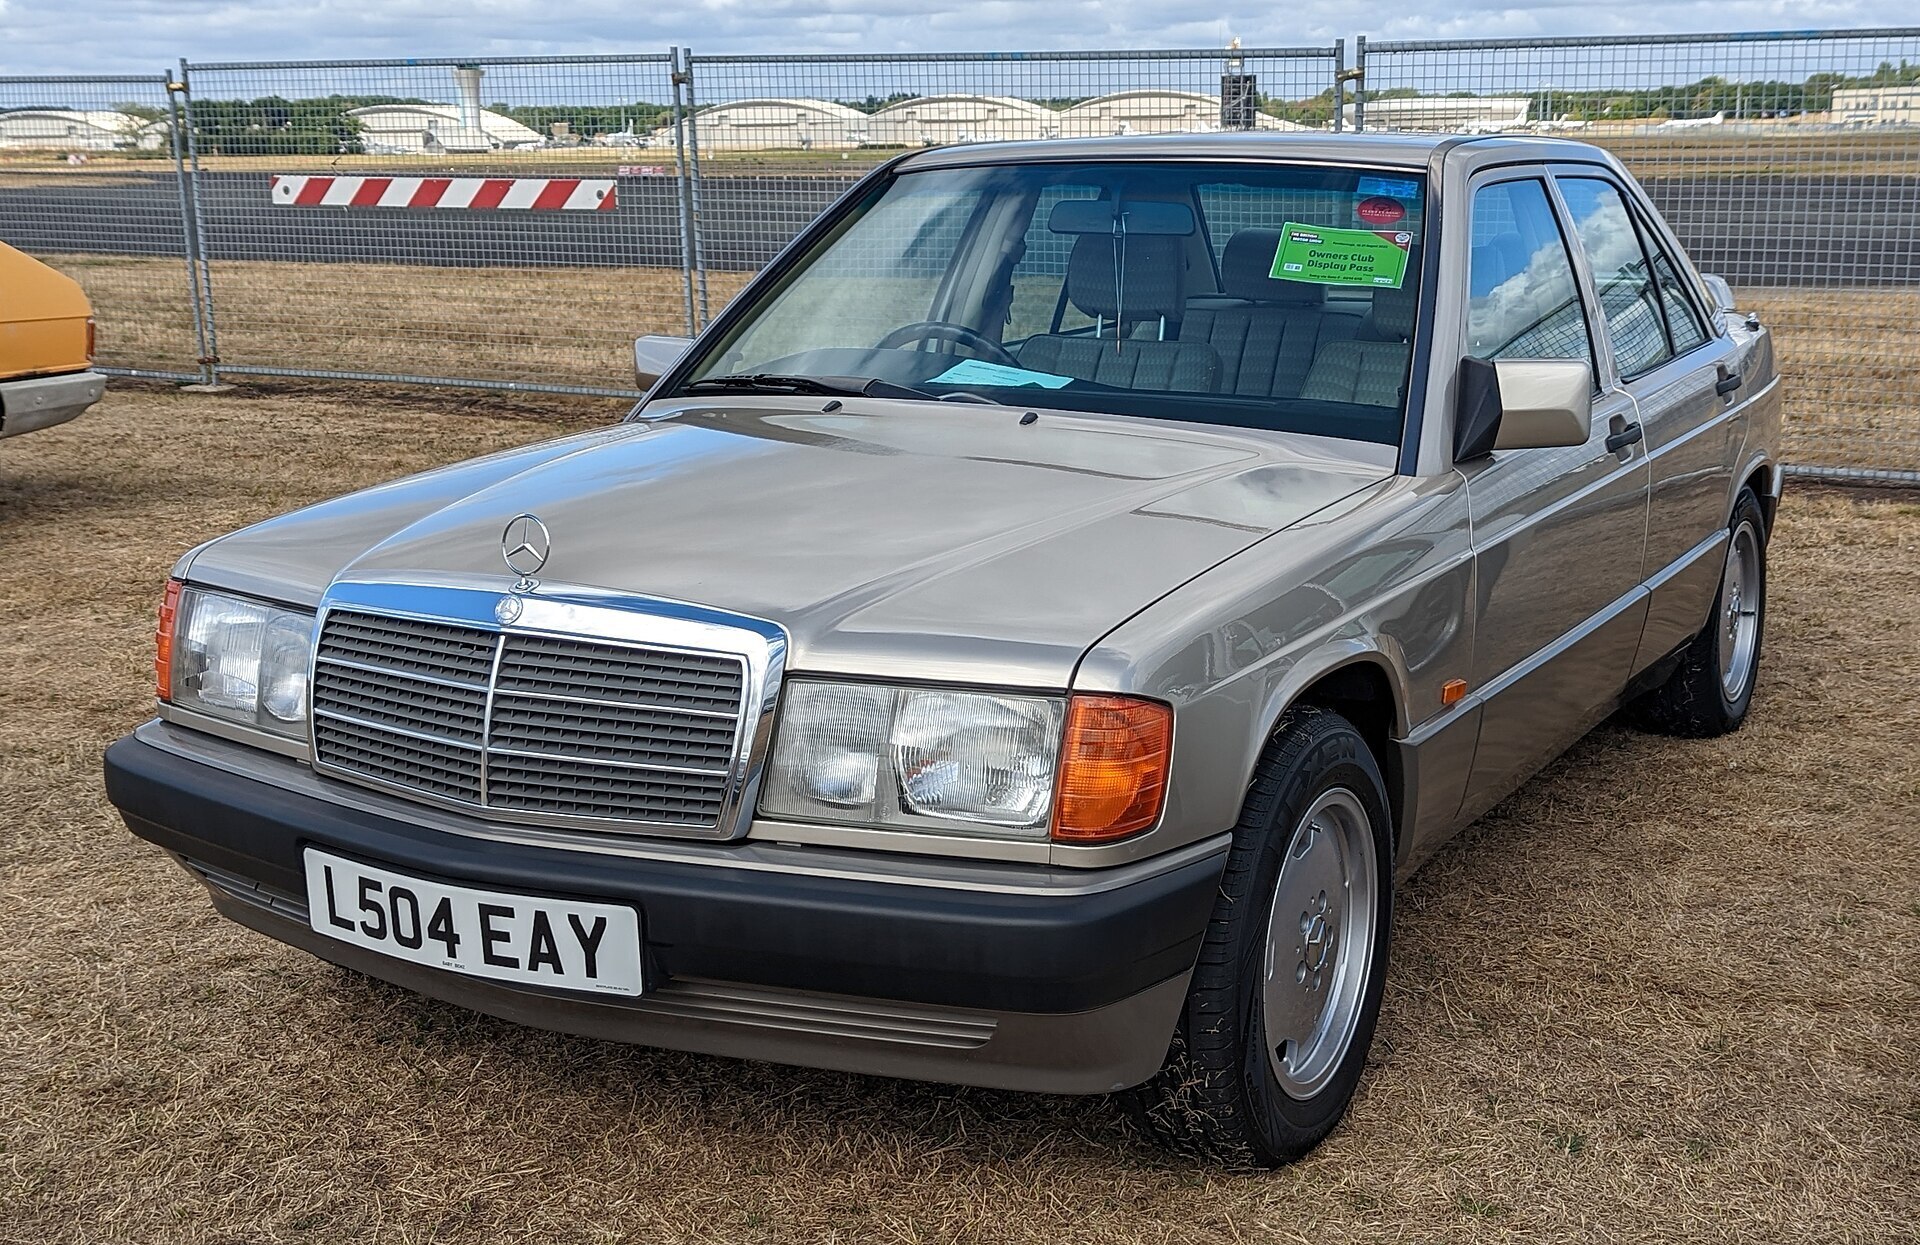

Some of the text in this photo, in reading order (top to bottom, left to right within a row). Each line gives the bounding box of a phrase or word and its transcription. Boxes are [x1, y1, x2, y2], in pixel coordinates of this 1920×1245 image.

[1308, 249, 1375, 263] Owners Club
[1306, 259, 1375, 273] Display Pass
[323, 865, 607, 979] L504 EAY
